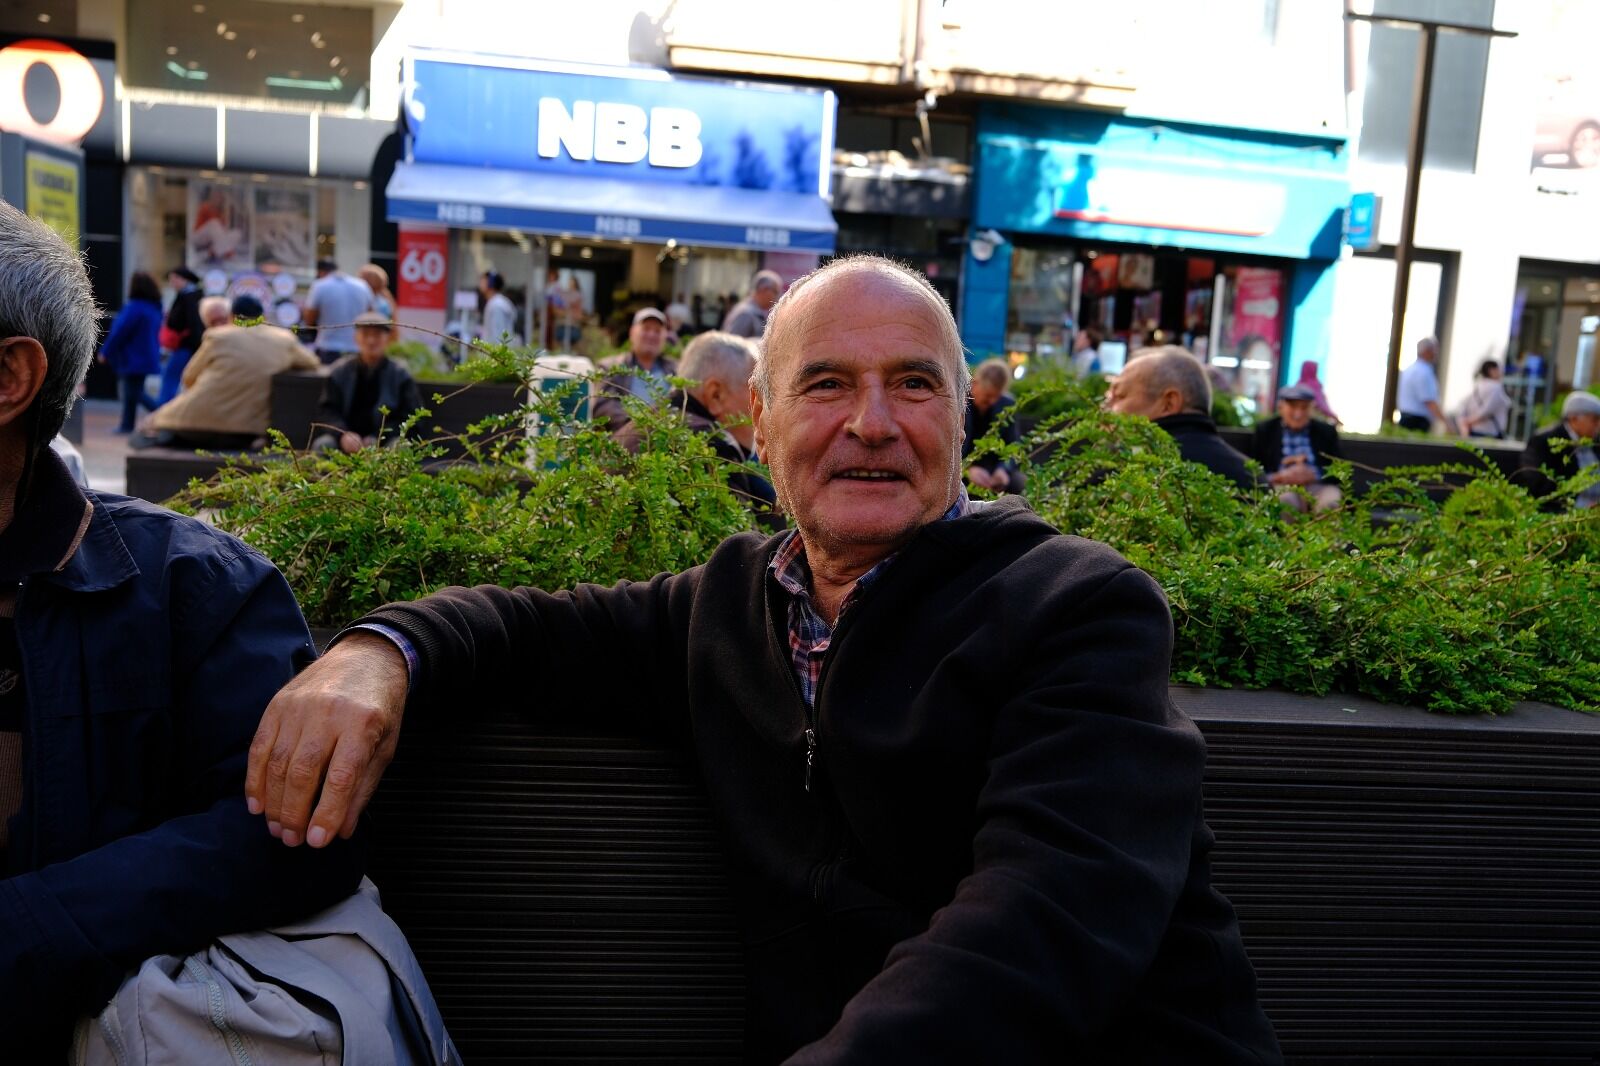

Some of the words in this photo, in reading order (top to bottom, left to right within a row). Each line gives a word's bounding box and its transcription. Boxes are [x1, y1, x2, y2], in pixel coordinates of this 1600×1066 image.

[538, 97, 703, 168] NBB
[437, 203, 485, 224] NBB
[595, 215, 642, 236] NBB
[745, 226, 791, 246] NBB
[401, 250, 446, 284] 60
